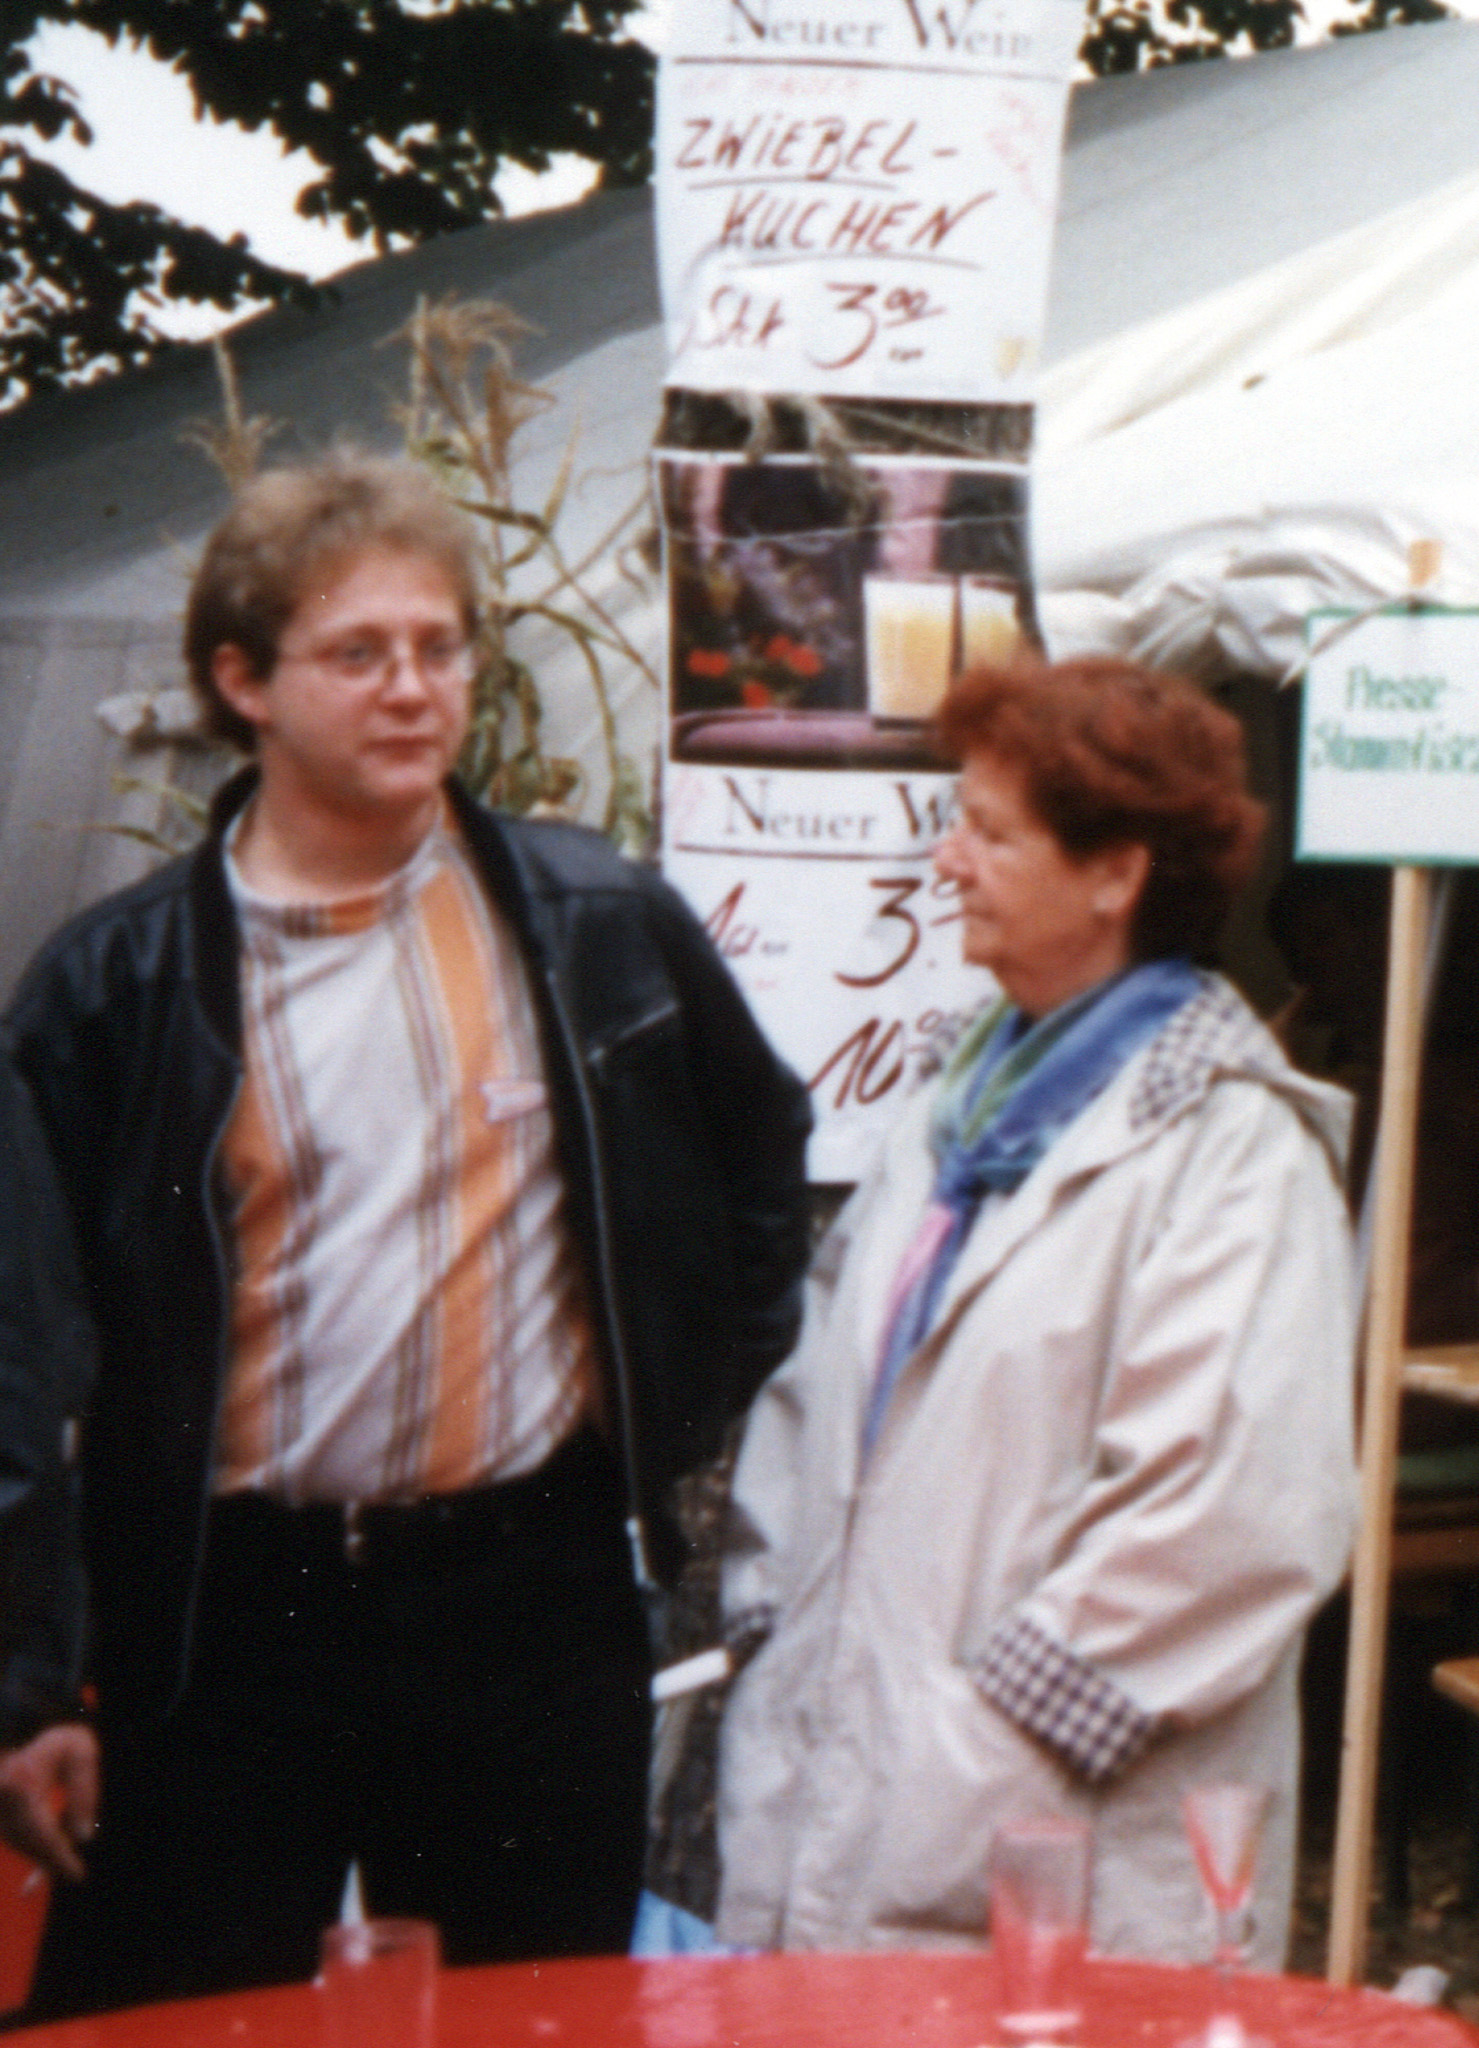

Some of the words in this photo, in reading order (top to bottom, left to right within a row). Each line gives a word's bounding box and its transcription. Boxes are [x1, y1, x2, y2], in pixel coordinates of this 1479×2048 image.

[724, 0, 884, 50] Neuer
[719, 190, 998, 252] KUCHEN
[722, 775, 880, 840] Neuer
